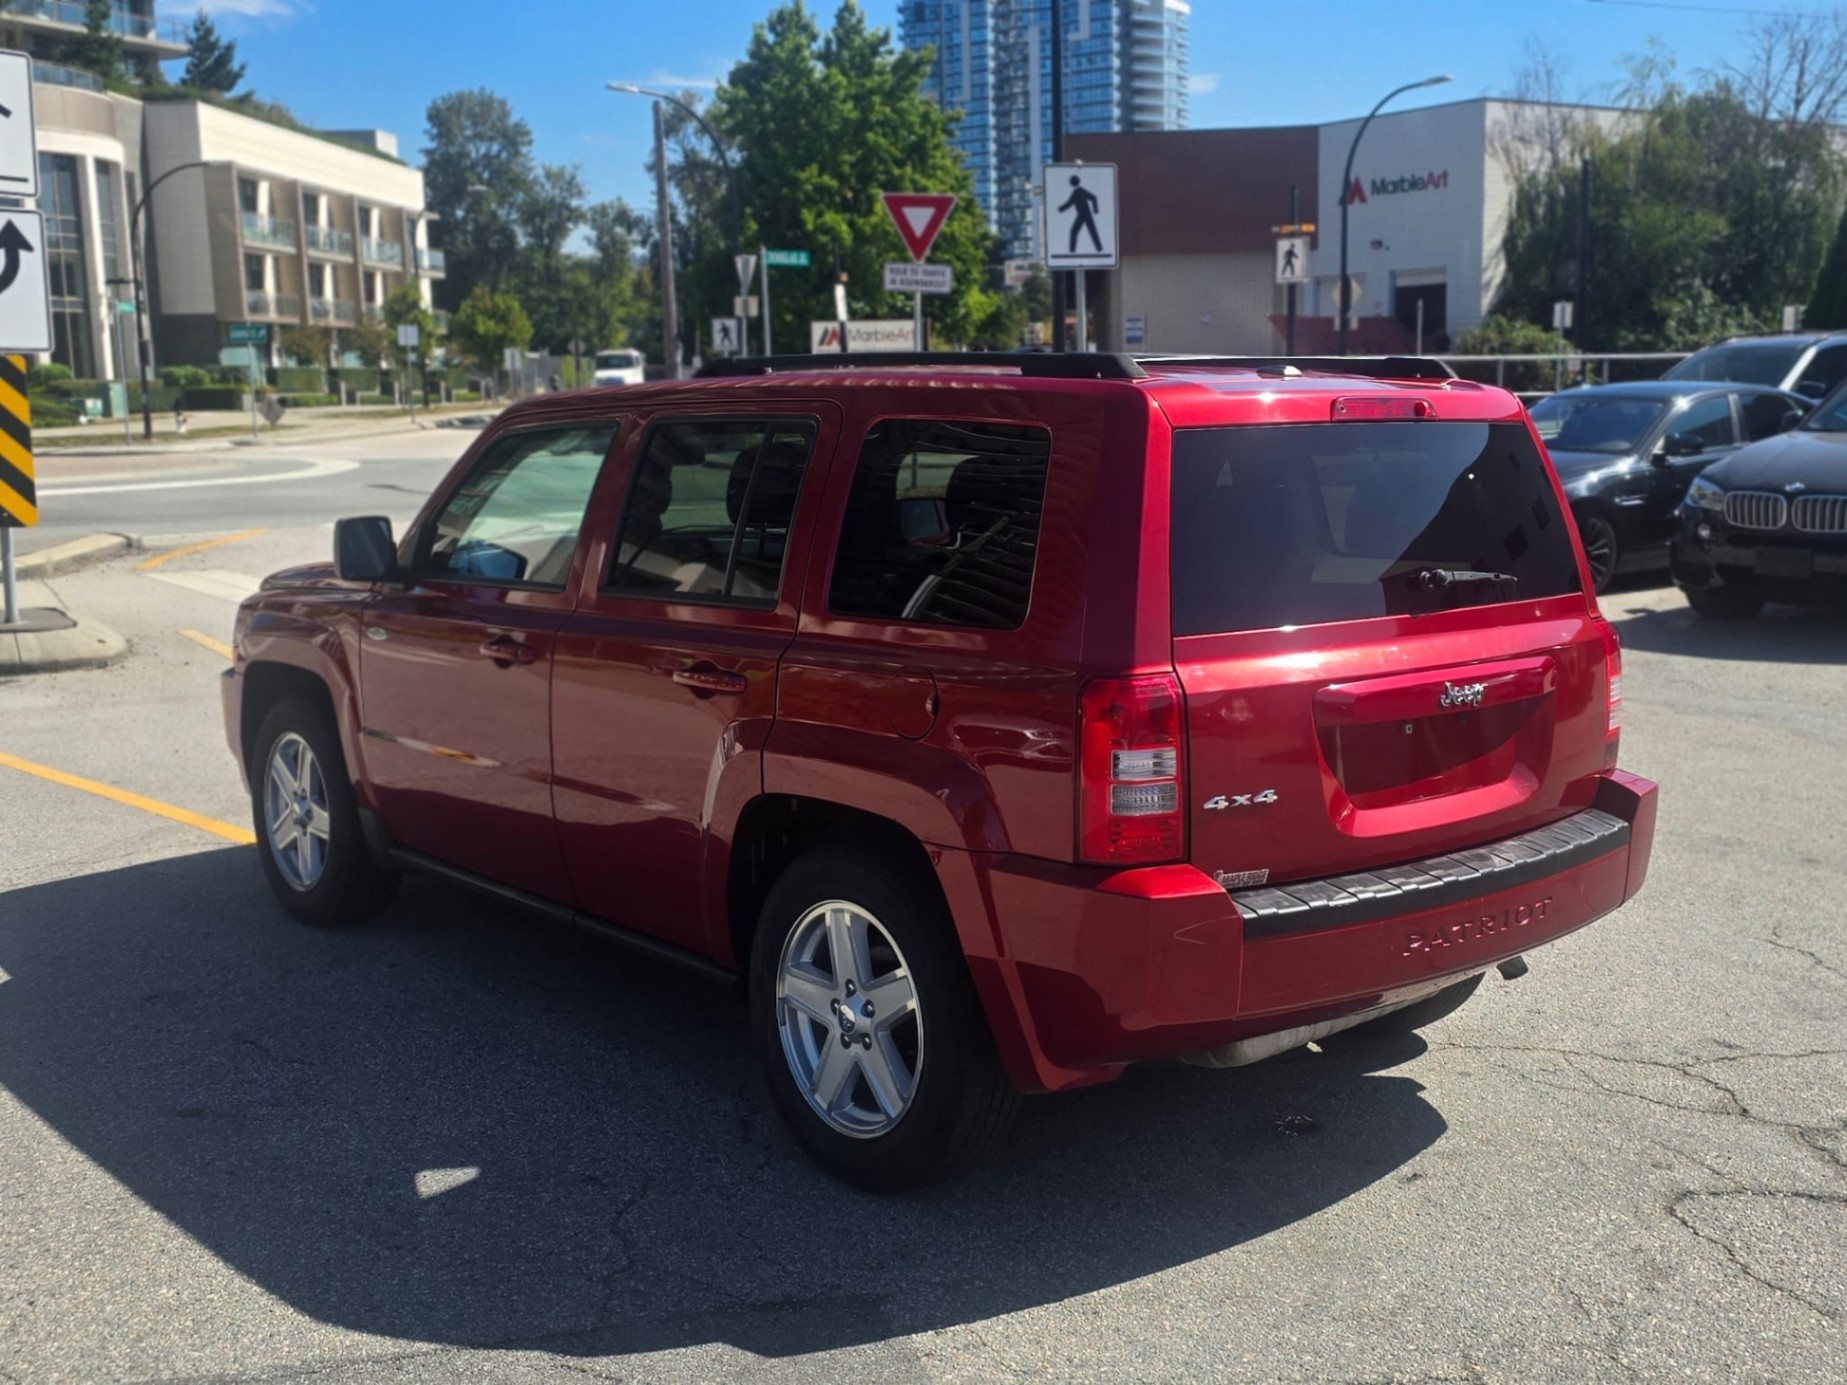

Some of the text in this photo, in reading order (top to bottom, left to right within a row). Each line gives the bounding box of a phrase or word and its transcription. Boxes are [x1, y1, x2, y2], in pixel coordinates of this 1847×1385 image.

[1371, 170, 1449, 196] MarbleArt
[847, 327, 915, 342] MarbleAr
[1440, 681, 1488, 707] Jeep
[1203, 789, 1278, 810] 4x4
[1223, 872, 1247, 883] MAPLE
[1403, 896, 1553, 956] PATRIOT
